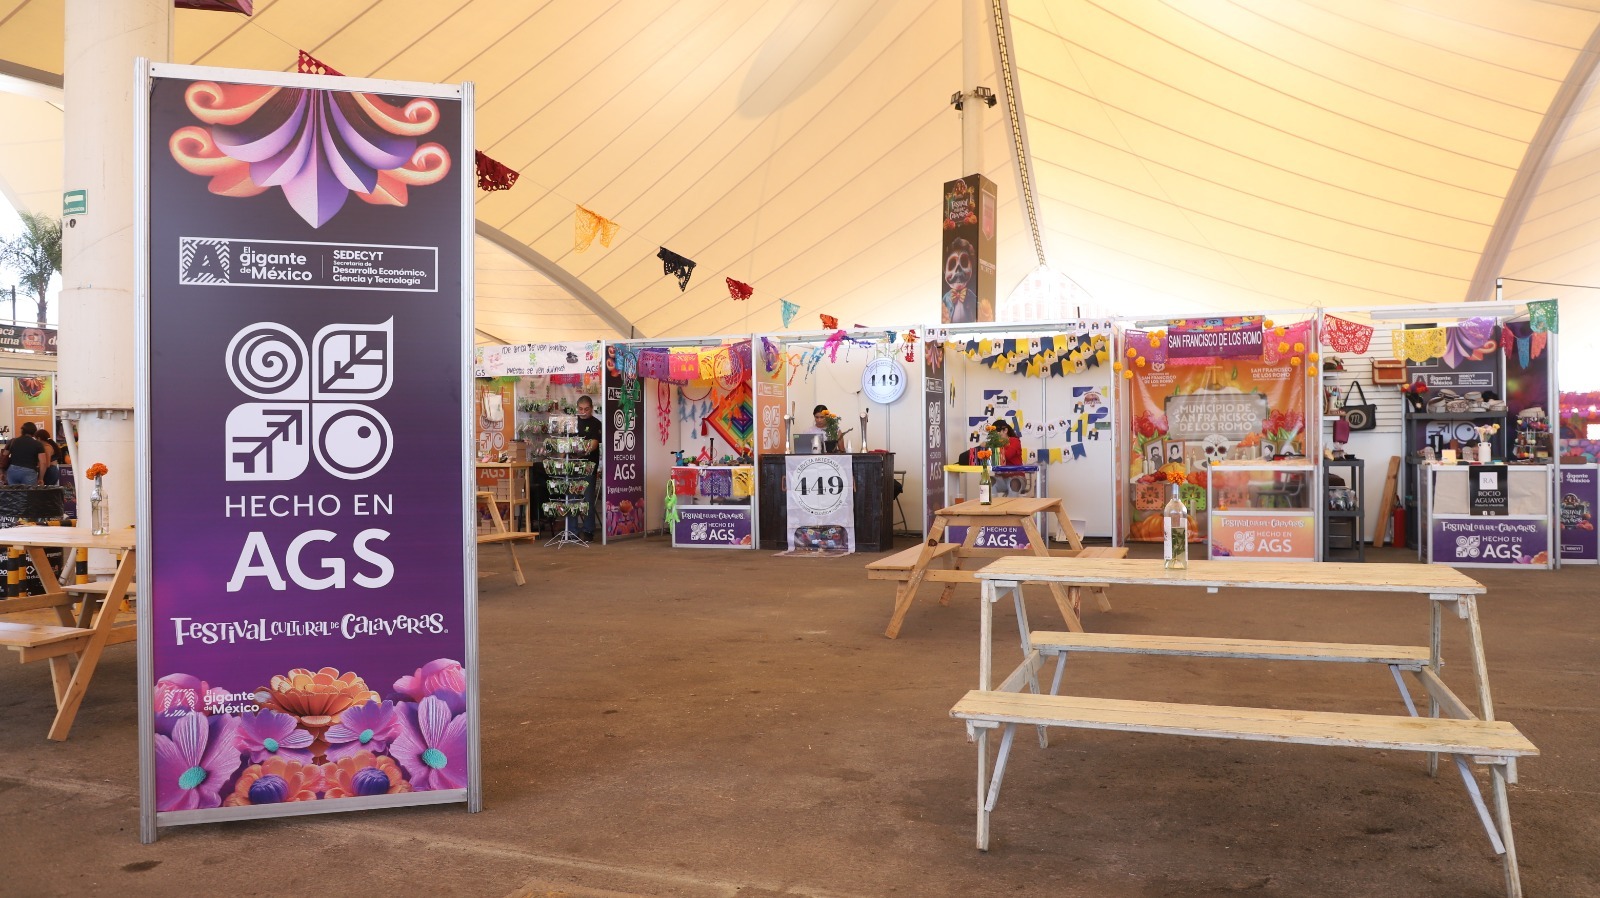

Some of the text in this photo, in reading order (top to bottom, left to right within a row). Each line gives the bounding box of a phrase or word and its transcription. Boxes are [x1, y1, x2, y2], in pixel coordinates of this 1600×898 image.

[243, 246, 251, 254] El
[333, 250, 384, 261] SEDECYT
[239, 251, 307, 266] gigante
[240, 266, 313, 281] de México
[332, 266, 428, 278] Desarrollo Económico,
[332, 274, 366, 283] Ciencia
[374, 275, 421, 286] Tecnología
[1168, 331, 1262, 348] SAN FRANCISCO DE LOS ROMO
[475, 369, 486, 377] GS
[867, 373, 900, 387] 449
[1180, 403, 1252, 413] MUNICIPIO DE
[1175, 412, 1257, 423] SAN FRANCISCO
[1180, 422, 1253, 432] DE LOS ROMO
[613, 463, 636, 481] AGS
[929, 461, 942, 481] AGS
[794, 475, 844, 496] 449
[225, 493, 393, 518] HECHO EN
[708, 528, 735, 541] AGS
[986, 534, 1018, 547] AGS
[1257, 538, 1293, 553] AGS
[1482, 543, 1523, 559] AGS
[226, 528, 395, 592] AGS
[203, 691, 255, 705] gigante
[212, 702, 260, 714] México
